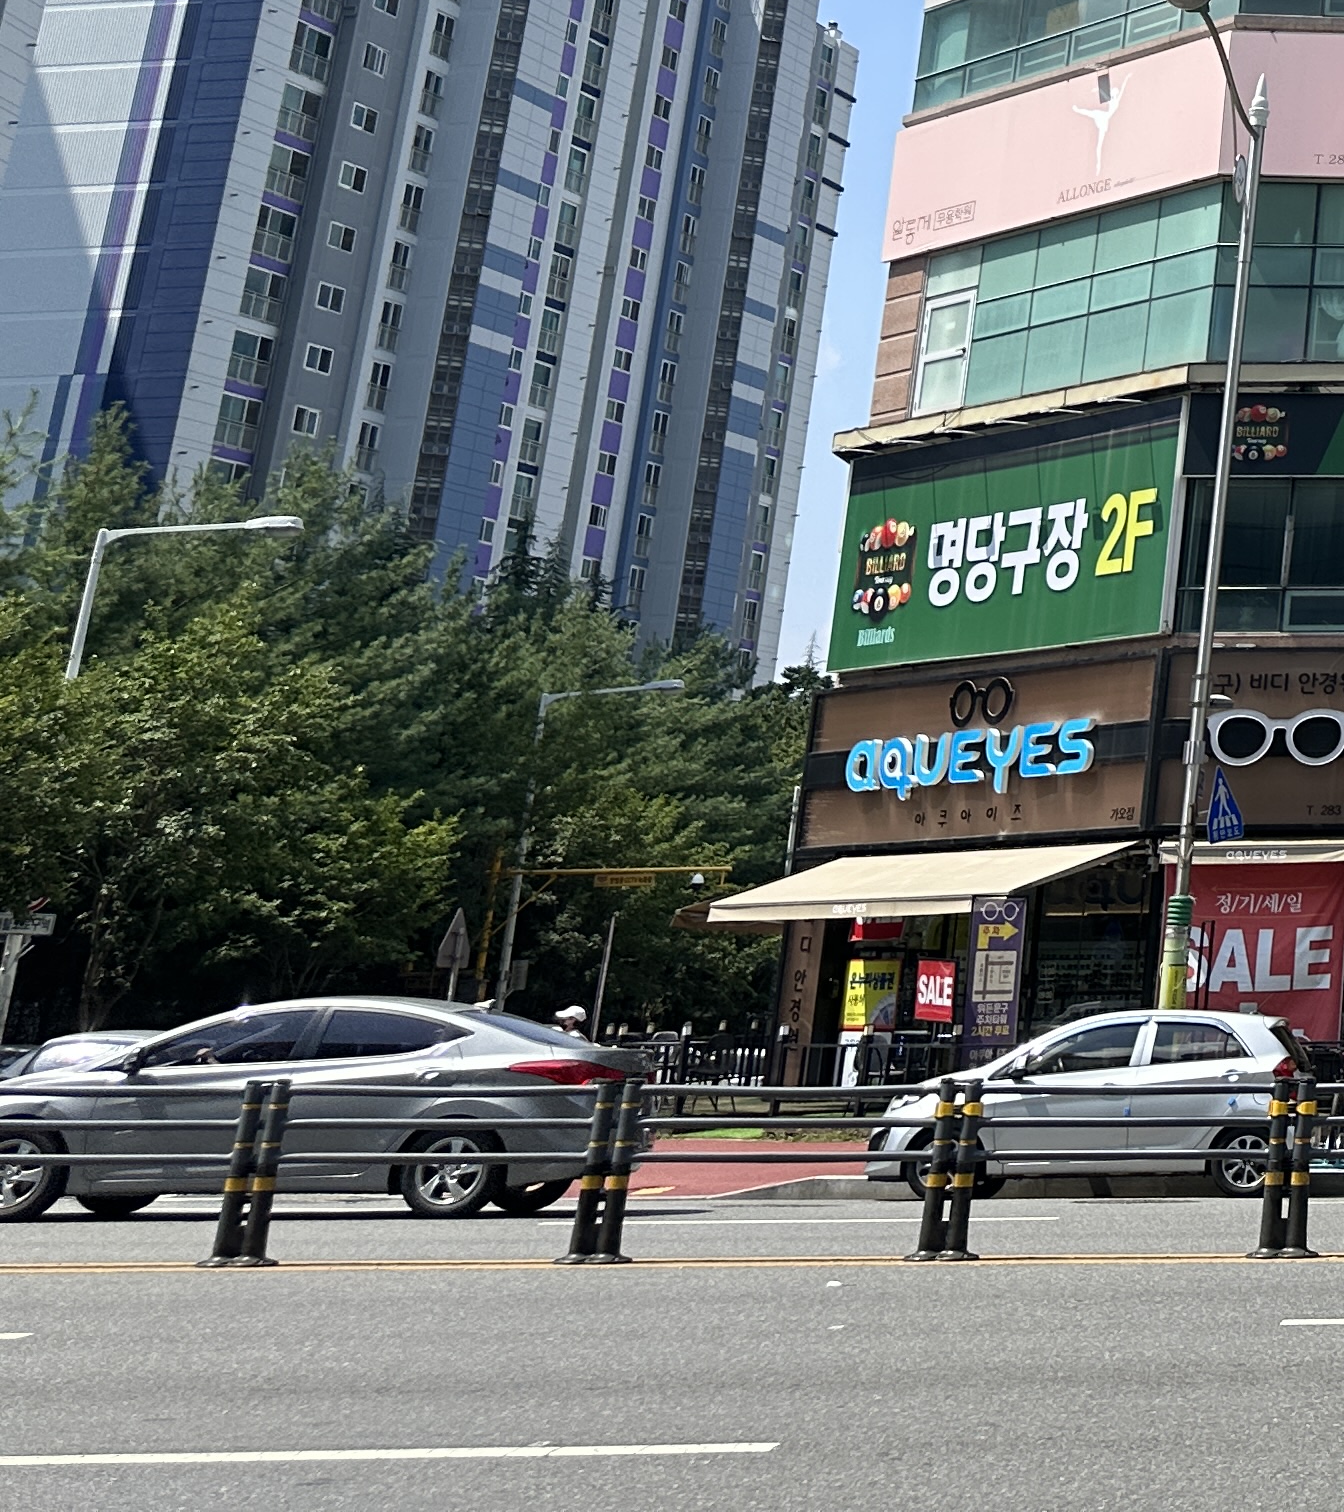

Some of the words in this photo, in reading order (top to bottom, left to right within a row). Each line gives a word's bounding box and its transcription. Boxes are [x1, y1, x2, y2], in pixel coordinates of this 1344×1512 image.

[1057, 176, 1112, 205] ALLONGE
[926, 496, 1090, 608] 명당구장
[1094, 487, 1158, 578] 2F
[865, 553, 906, 576] BILLIARD
[856, 624, 896, 648] Billiards
[1250, 672, 1286, 692] 비디
[1320, 804, 1342, 816] 283
[1186, 925, 1334, 993] SALE
[917, 974, 954, 1007] SALE
